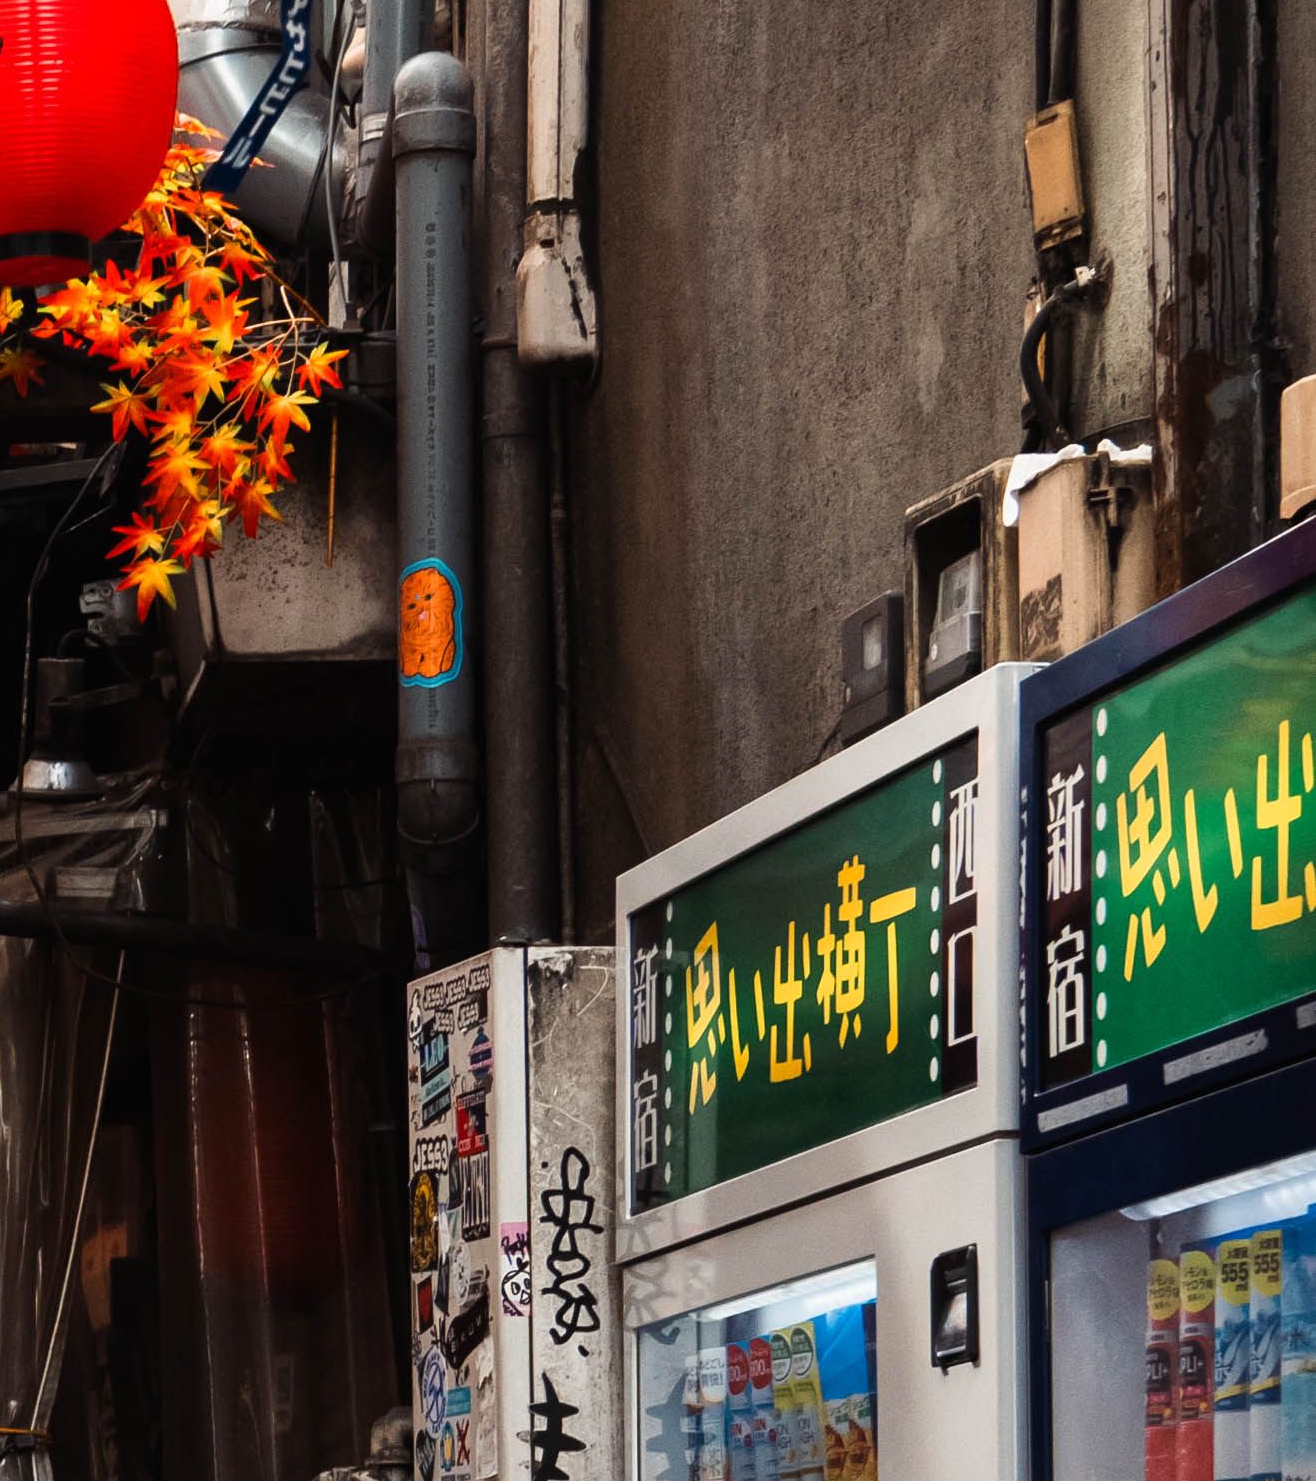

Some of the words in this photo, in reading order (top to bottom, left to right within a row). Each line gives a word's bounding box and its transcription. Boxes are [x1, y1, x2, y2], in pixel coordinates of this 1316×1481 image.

[685, 854, 917, 1116] 思い出横丁
[1045, 763, 1086, 1058] 新宿
[630, 943, 659, 1173] 新宿
[1220, 1261, 1249, 1284] 555
